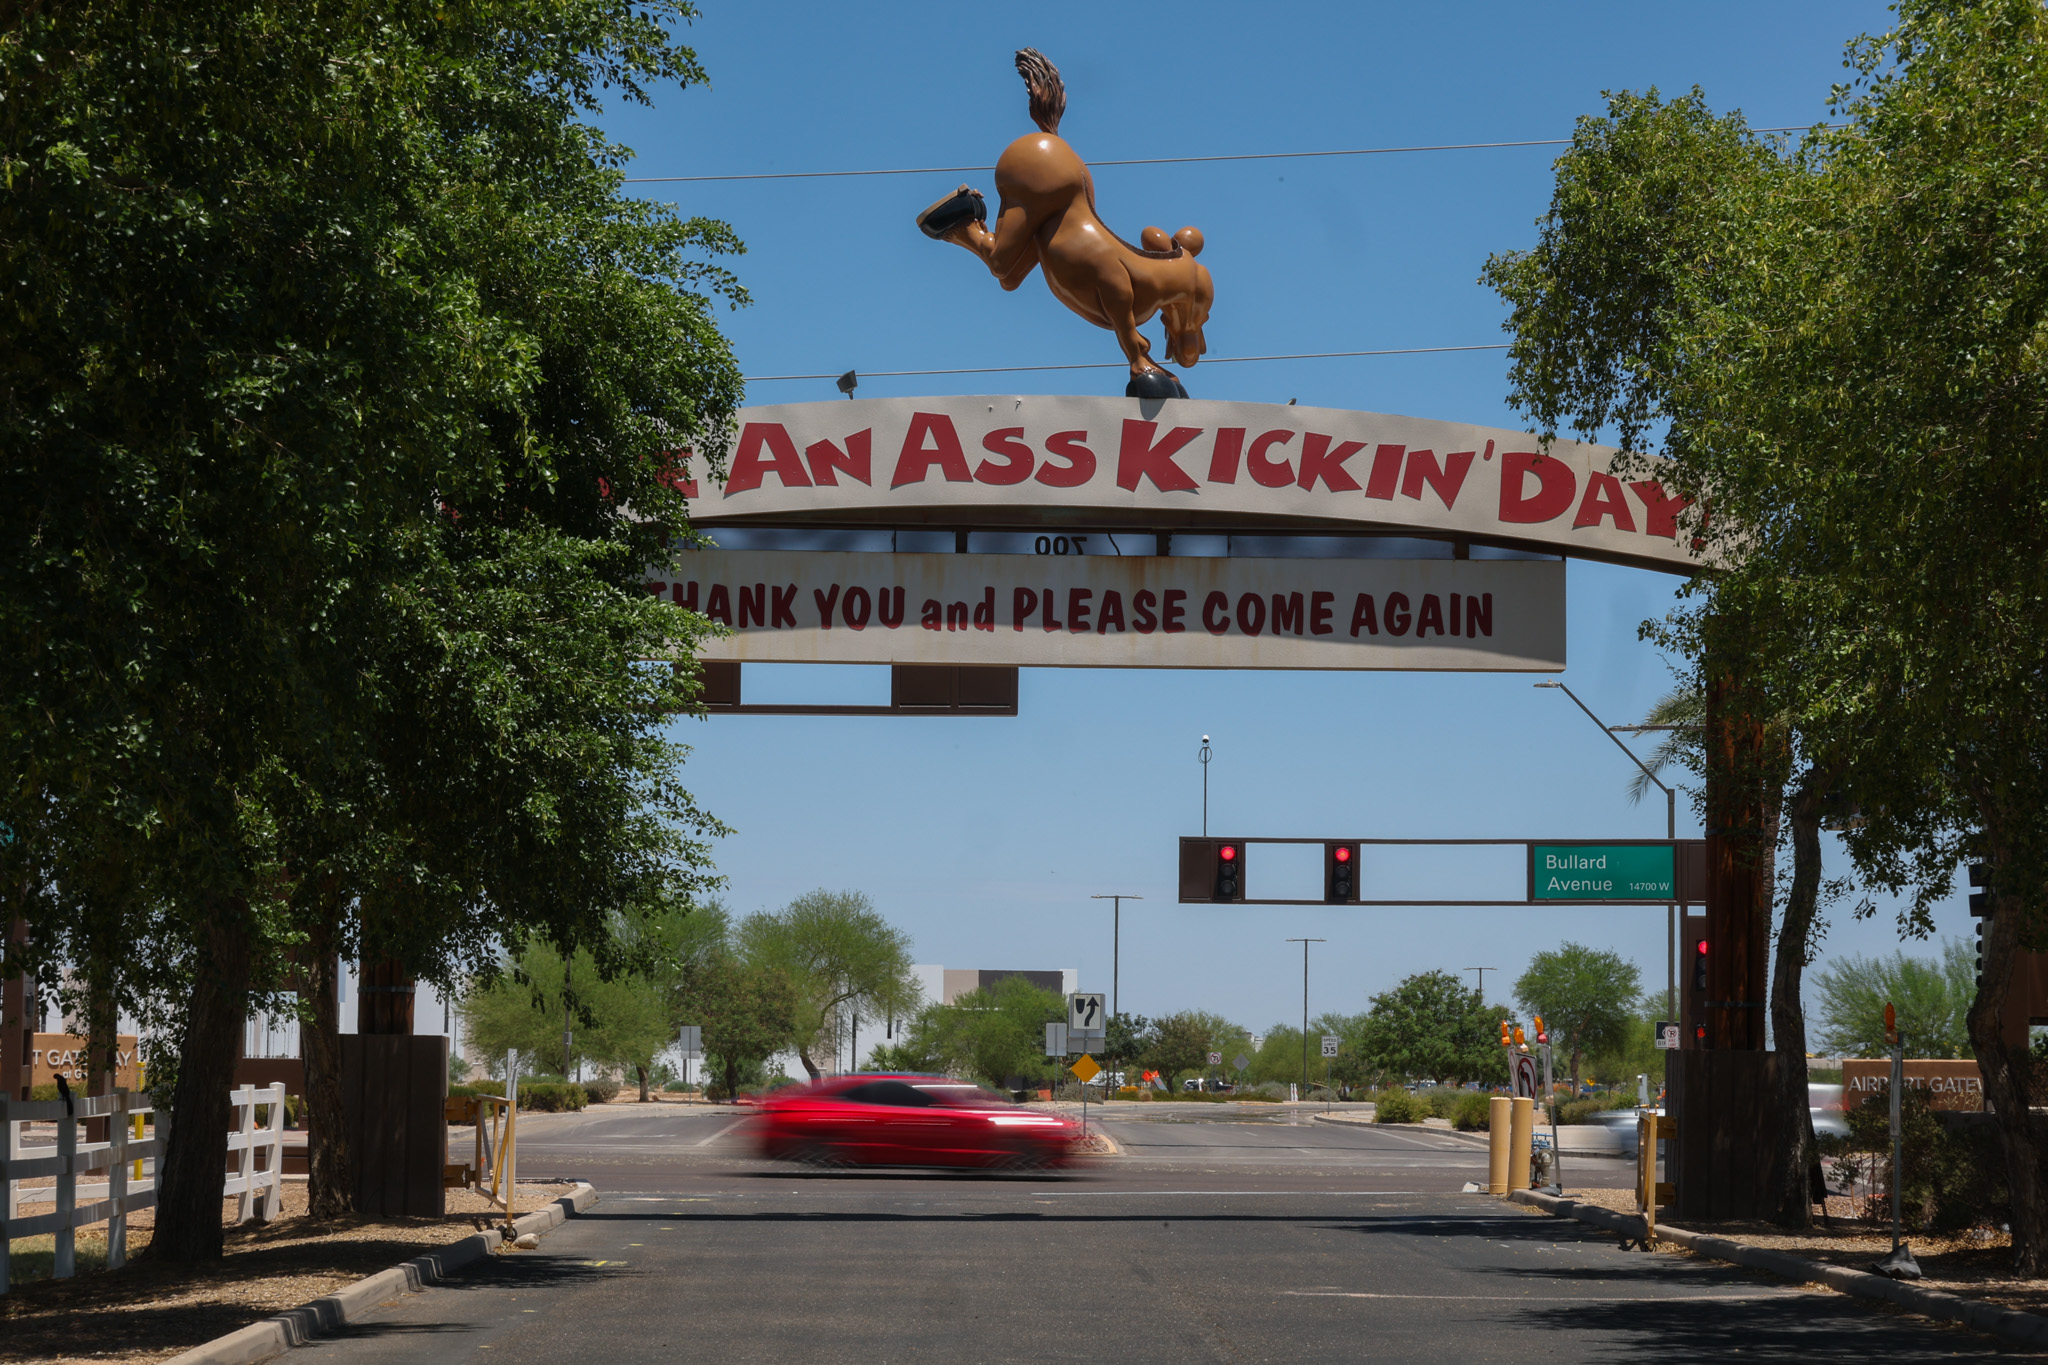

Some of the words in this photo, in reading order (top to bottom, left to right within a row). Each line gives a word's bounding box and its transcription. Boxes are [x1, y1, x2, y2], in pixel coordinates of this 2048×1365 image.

[724, 422, 872, 494] AN
[891, 411, 1097, 488] ASS
[1117, 418, 1496, 509] KICKIN'
[813, 583, 906, 630] YOU
[920, 586, 996, 632] and
[1012, 586, 1188, 635] PLEASE
[1202, 590, 1336, 637] COME
[1349, 591, 1494, 638] AGAIN
[1546, 854, 1607, 870] Bullard
[1547, 876, 1613, 891] Avenue
[1629, 882, 1657, 891] 14700
[1659, 882, 1670, 891] W
[1848, 1075, 1925, 1092] AIRPRT
